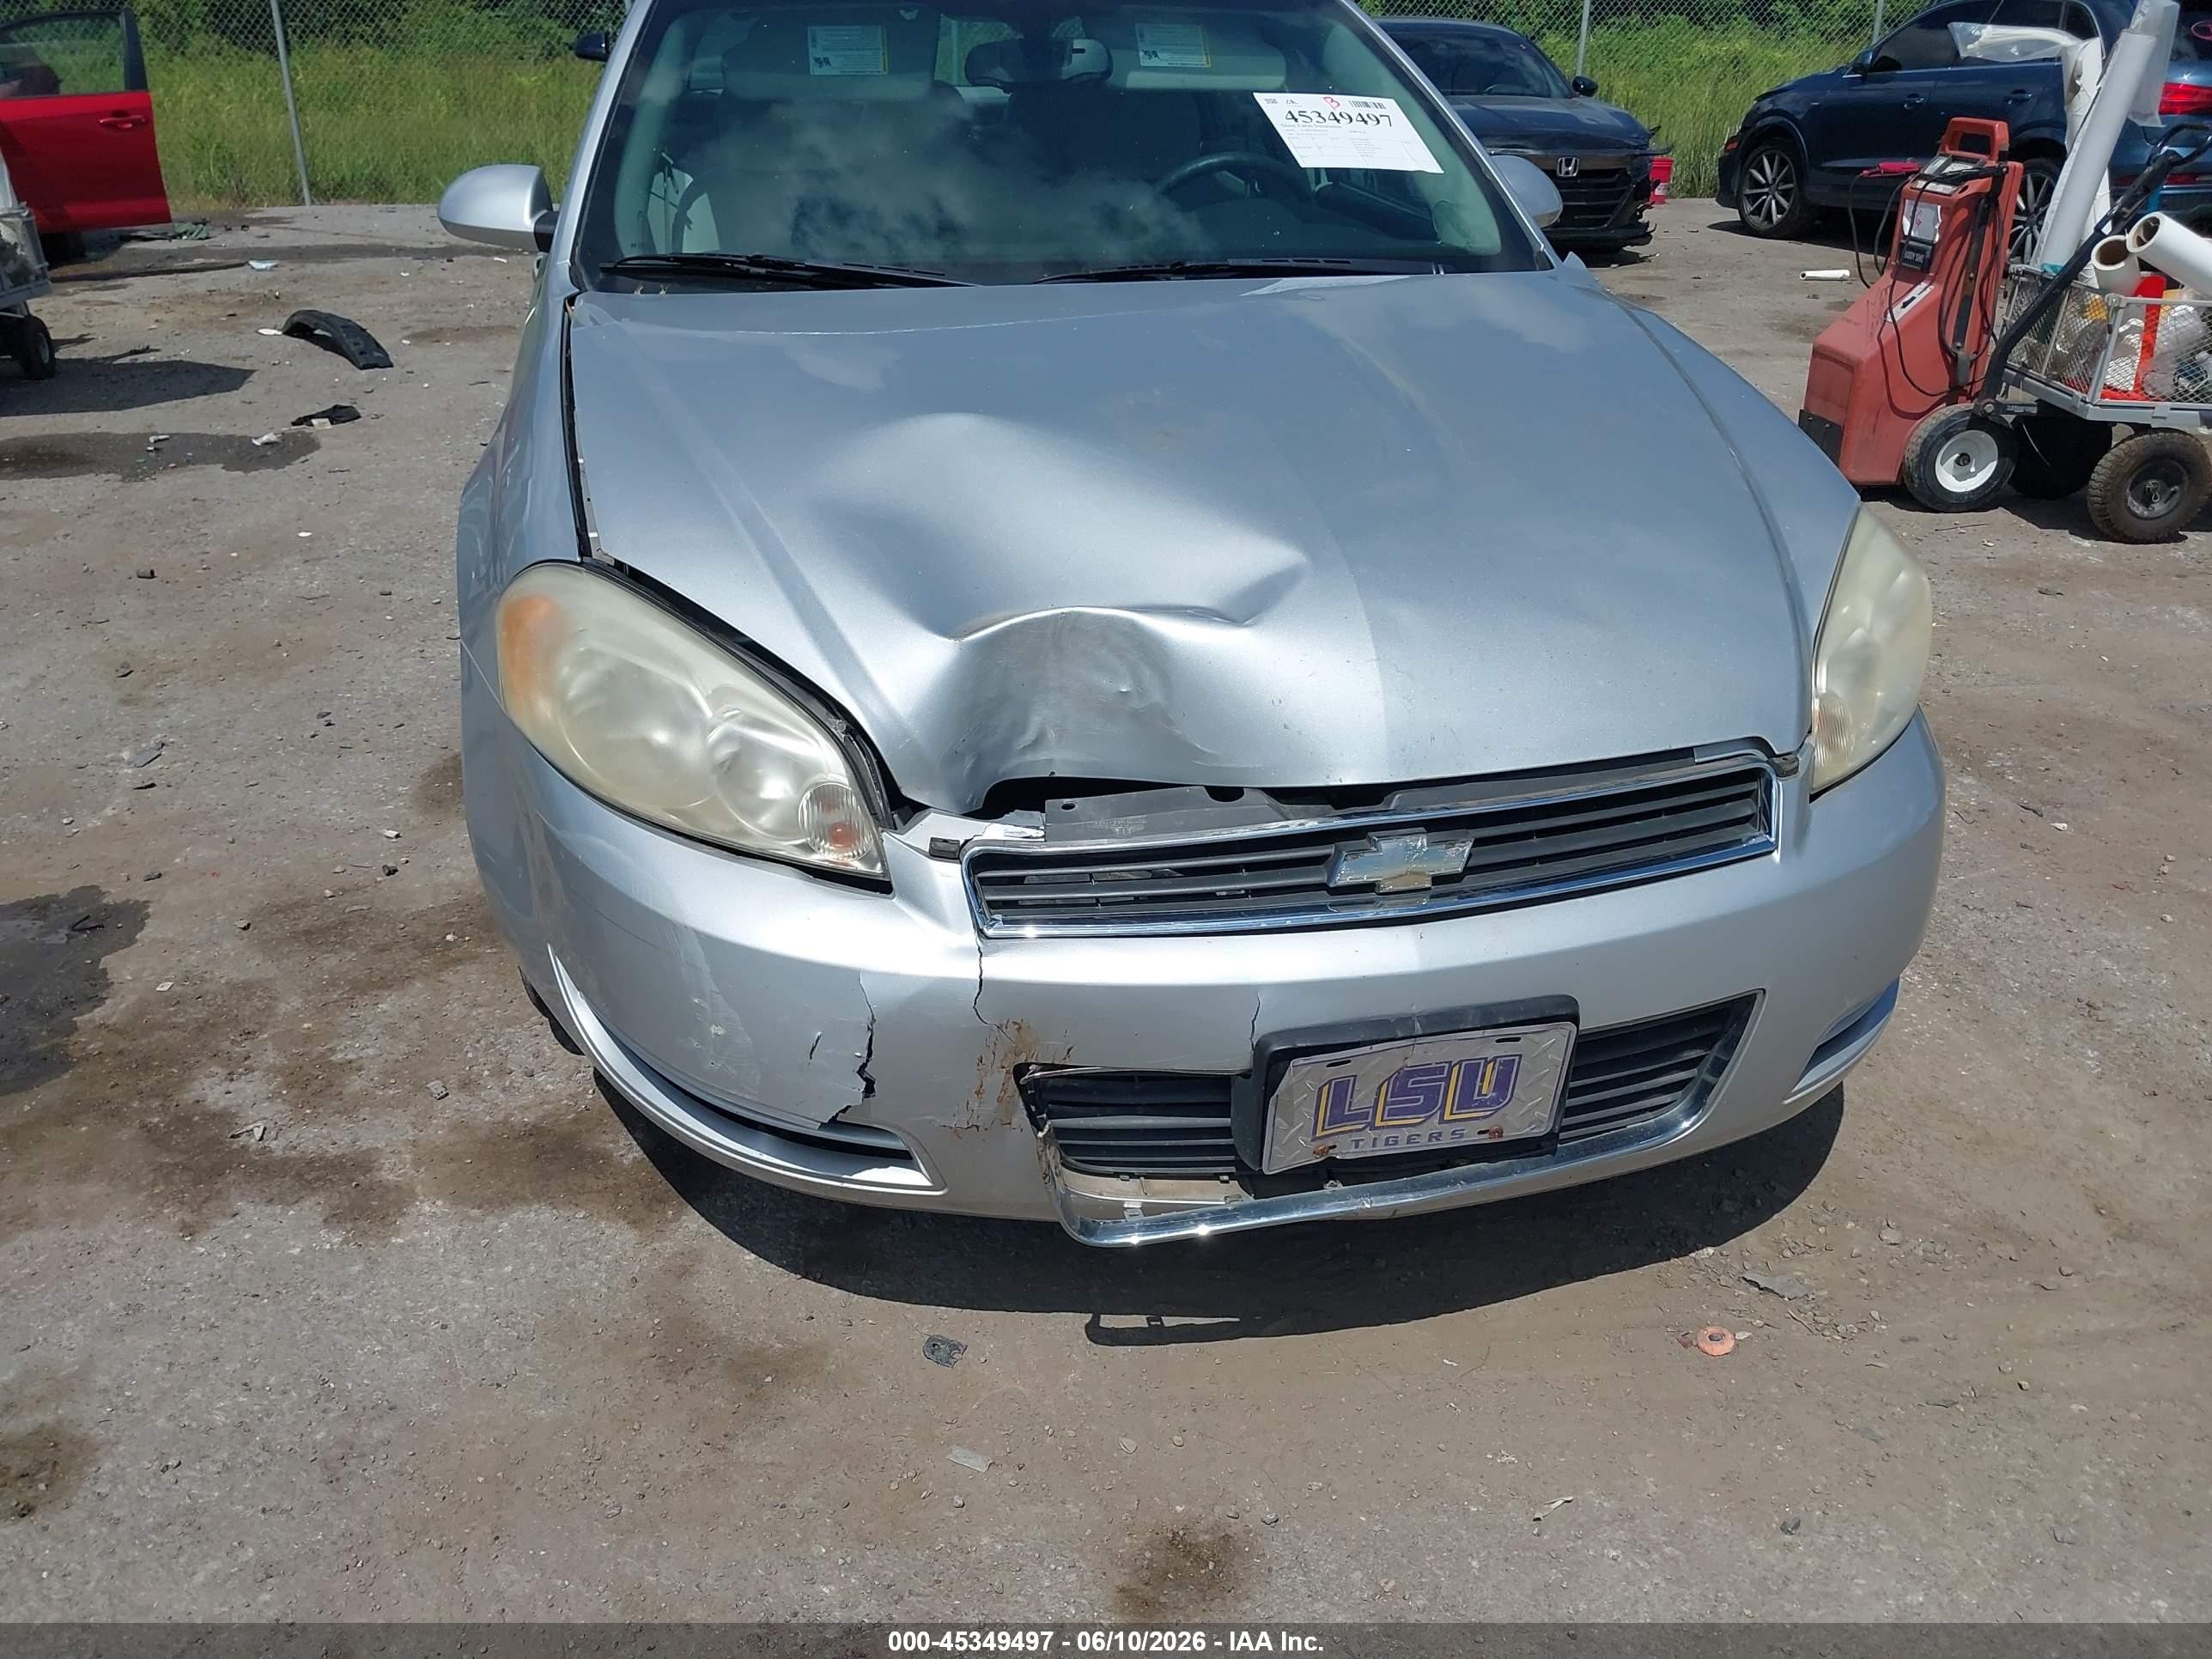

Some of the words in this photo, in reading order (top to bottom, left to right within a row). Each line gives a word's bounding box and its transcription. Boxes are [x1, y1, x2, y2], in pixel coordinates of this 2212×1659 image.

[1285, 110, 1393, 127] 45349497
[1312, 1054, 1522, 1140] LSU
[1351, 1128, 1465, 1149] TIGERS
